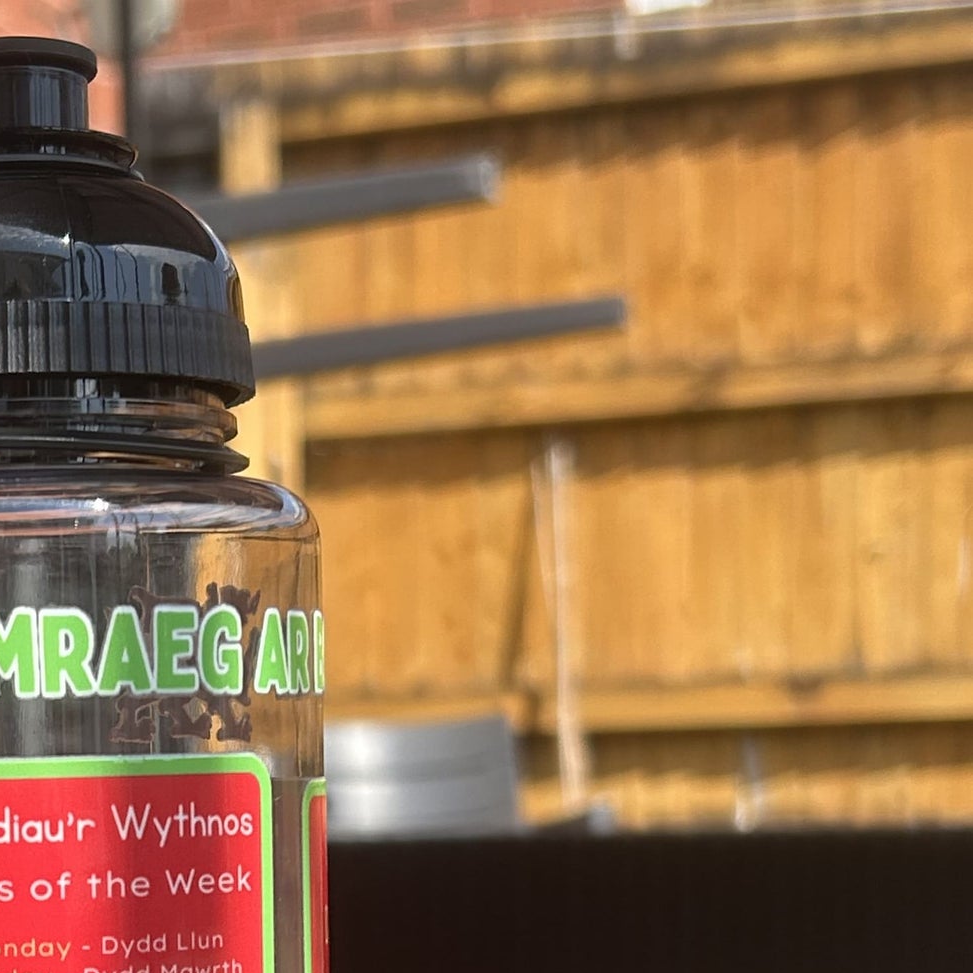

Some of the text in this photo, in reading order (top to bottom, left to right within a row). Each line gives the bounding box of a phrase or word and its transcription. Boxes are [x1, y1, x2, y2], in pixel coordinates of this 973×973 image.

[254, 607, 310, 694] AR
[111, 801, 253, 848] Wythnos
[30, 871, 71, 901] of
[87, 870, 150, 899] the
[165, 864, 251, 895] Week
[102, 933, 166, 959] Dydd
[177, 931, 223, 951] Llun
